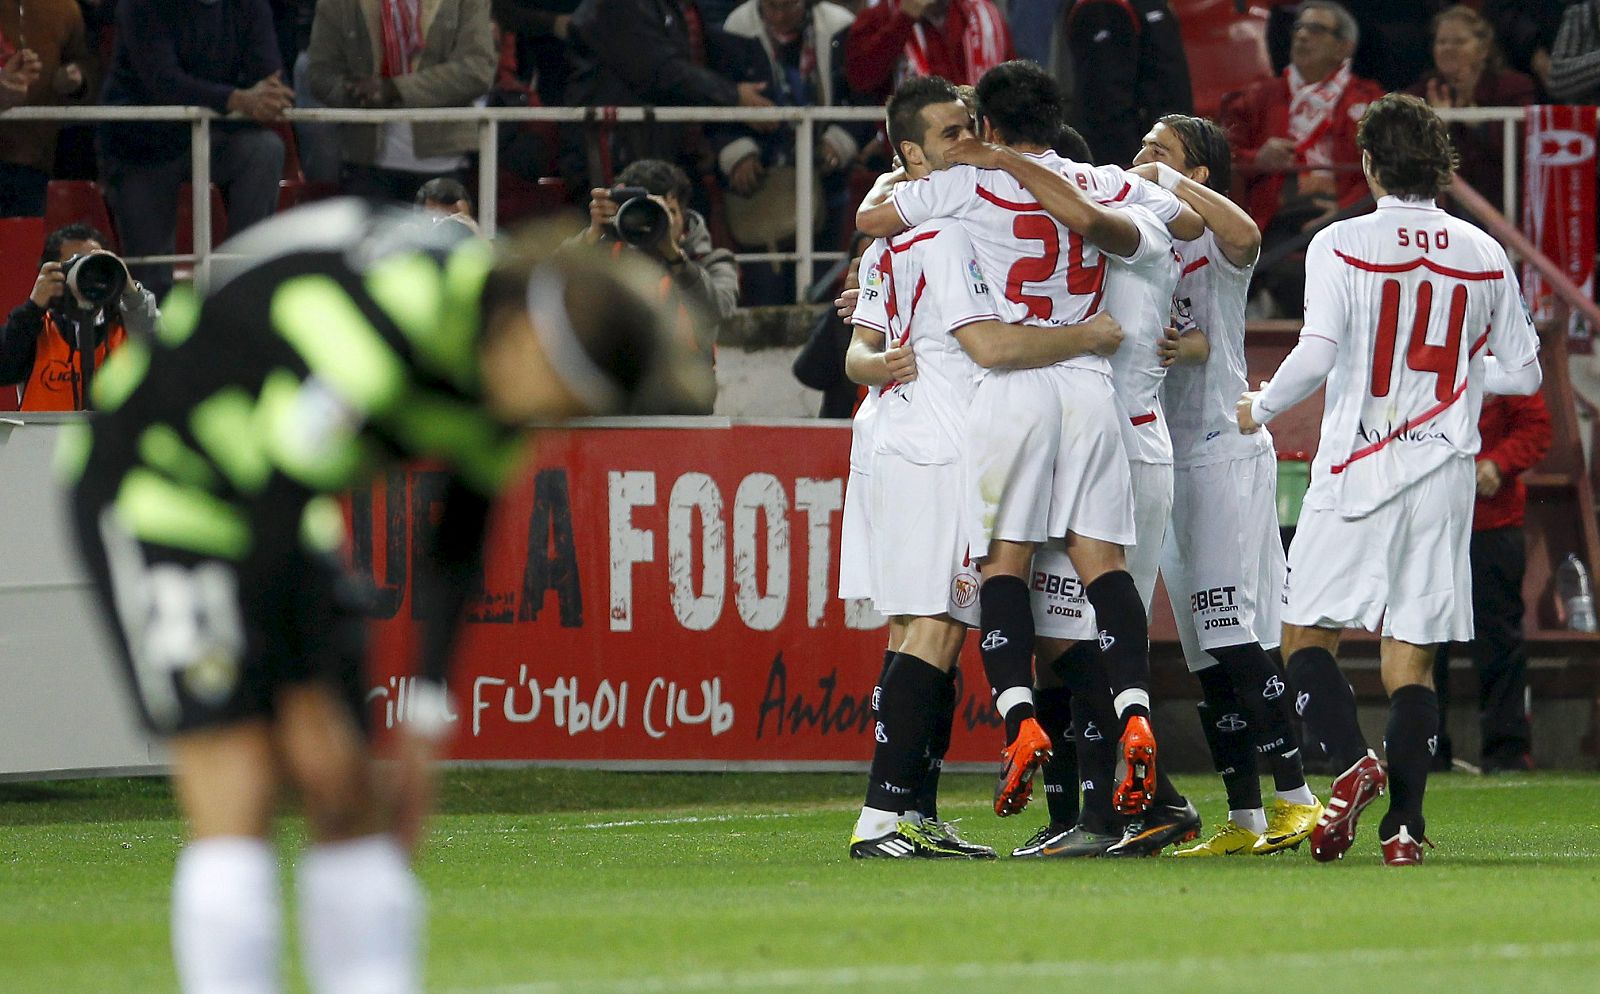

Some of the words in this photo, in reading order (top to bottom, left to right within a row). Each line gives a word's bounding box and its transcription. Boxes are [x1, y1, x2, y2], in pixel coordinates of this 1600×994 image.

[1397, 226, 1449, 253] sqd
[1370, 278, 1468, 401] 14
[608, 471, 888, 632] FOOT
[757, 650, 878, 739] Anton
